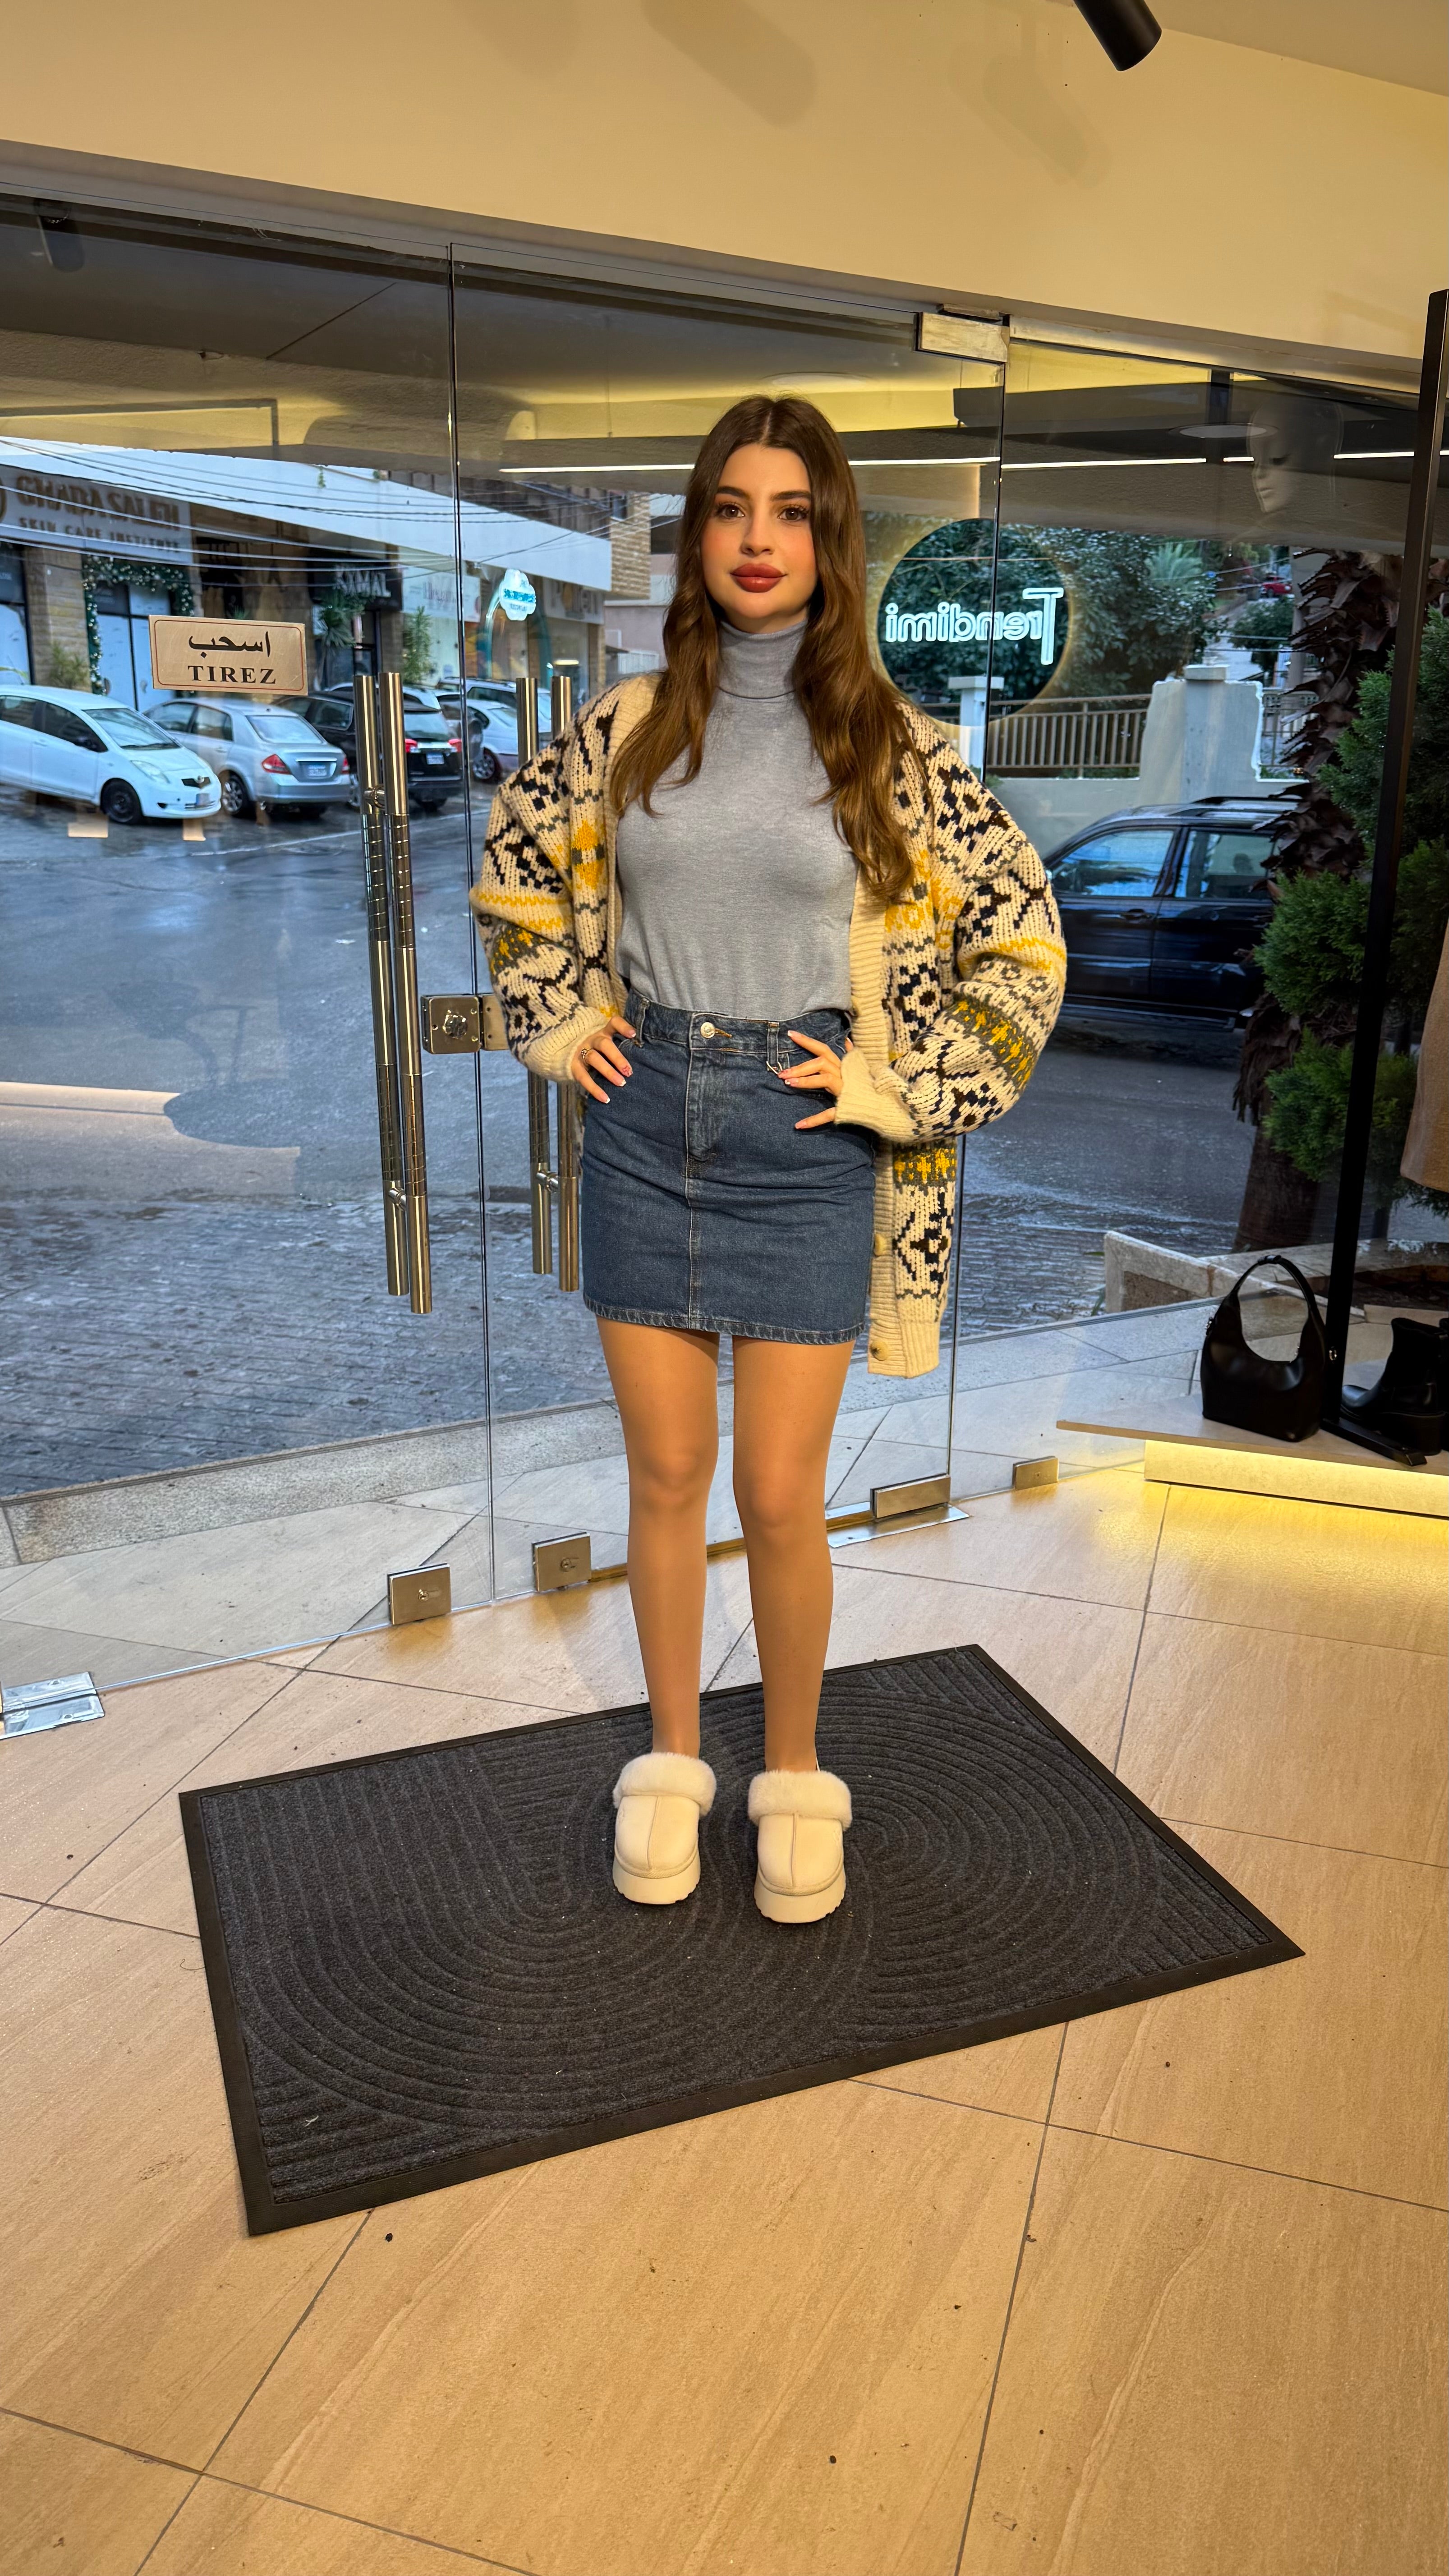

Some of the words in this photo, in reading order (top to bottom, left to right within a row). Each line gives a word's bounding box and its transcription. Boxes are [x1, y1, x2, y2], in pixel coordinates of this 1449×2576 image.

[19, 517, 56, 532] SKIN
[64, 525, 102, 539] CARE
[189, 631, 271, 658] اسحب
[188, 665, 276, 684] TIREZ
